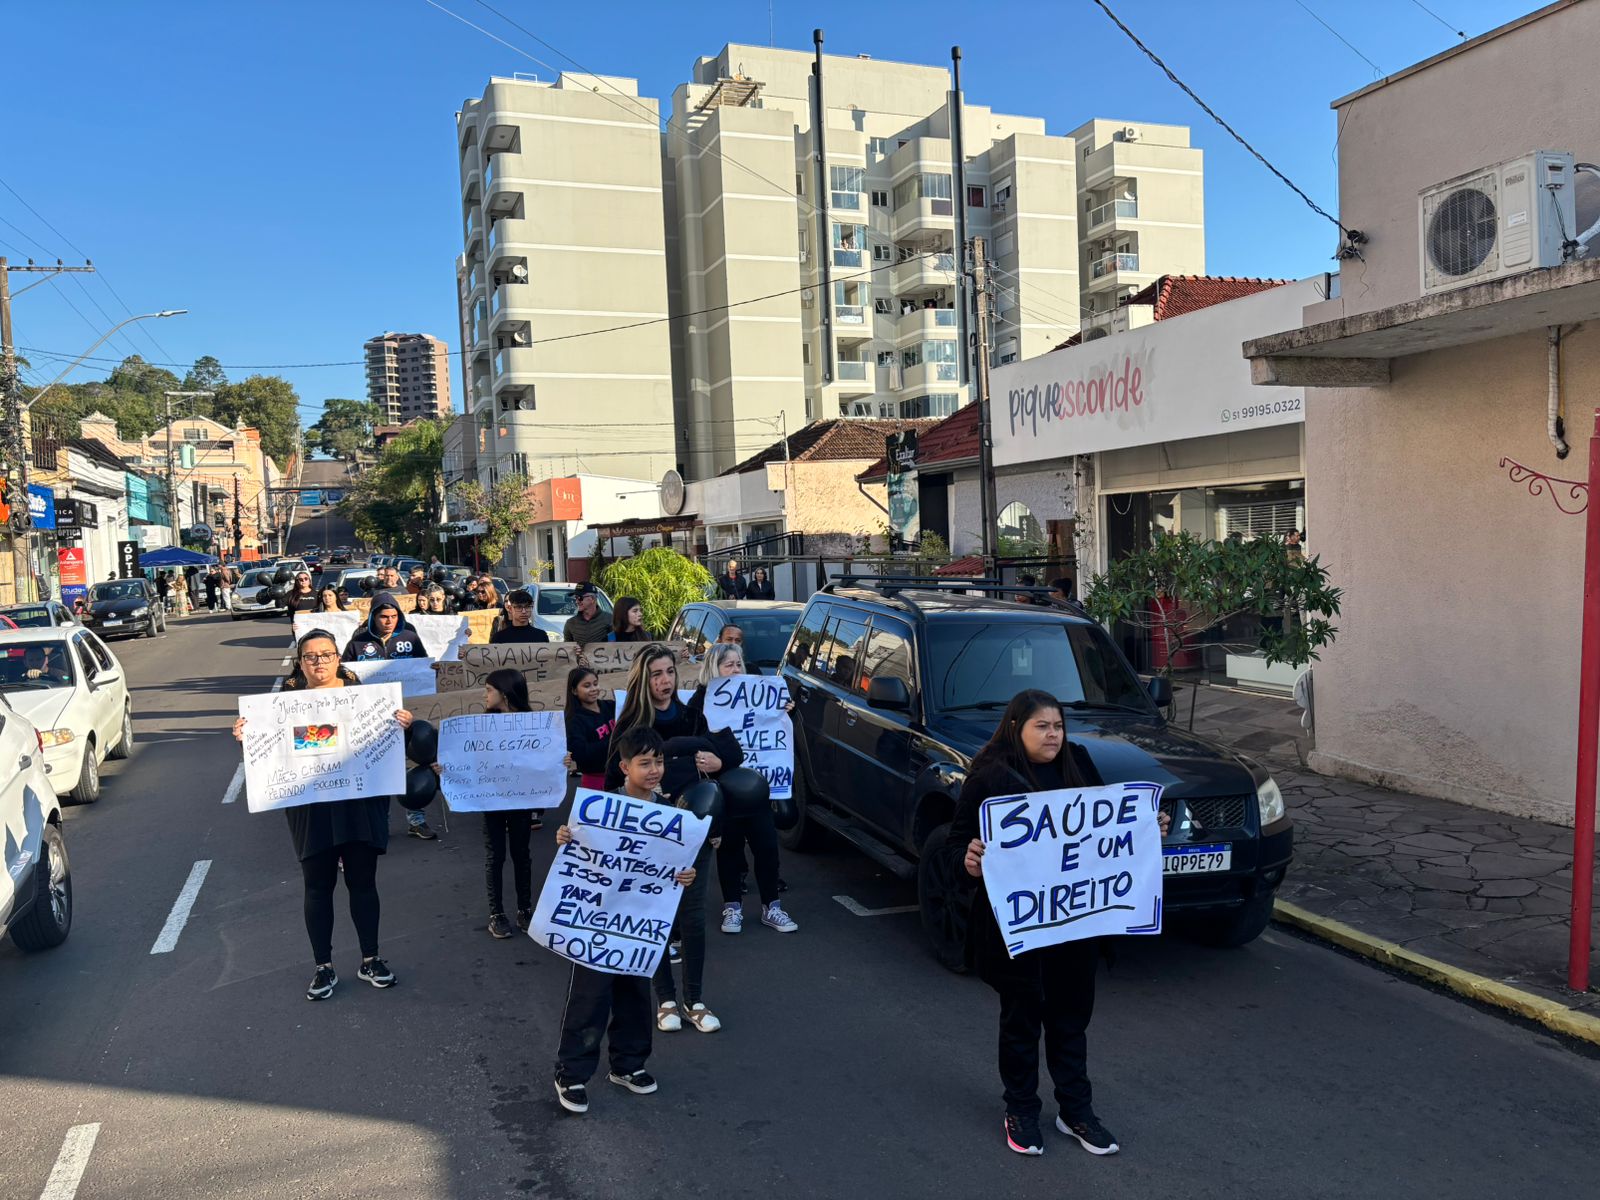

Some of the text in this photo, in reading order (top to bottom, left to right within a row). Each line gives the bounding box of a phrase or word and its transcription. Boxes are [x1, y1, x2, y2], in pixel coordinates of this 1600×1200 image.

[1232, 399, 1301, 420] 51 99195.0322
[123, 543, 134, 578] ÓPTI
[396, 641, 413, 653] 89
[465, 645, 570, 667] CRIANÇA
[713, 679, 791, 711] SAÚDE
[442, 715, 497, 735] PREFEITA
[742, 709, 755, 729] É
[463, 740, 494, 753] ONDE
[733, 730, 787, 750] EVER
[267, 761, 341, 785] MÃES CHORAM
[313, 778, 351, 790] SOCORRO
[579, 795, 683, 841] CHEGA
[1000, 793, 1139, 849] SAÚDE
[616, 836, 647, 854] DE
[1061, 831, 1134, 872] É UM
[1163, 852, 1224, 873] IQP9E79
[559, 861, 612, 887] ISSO
[561, 884, 603, 907] PARA
[551, 901, 671, 941] ENGANAR
